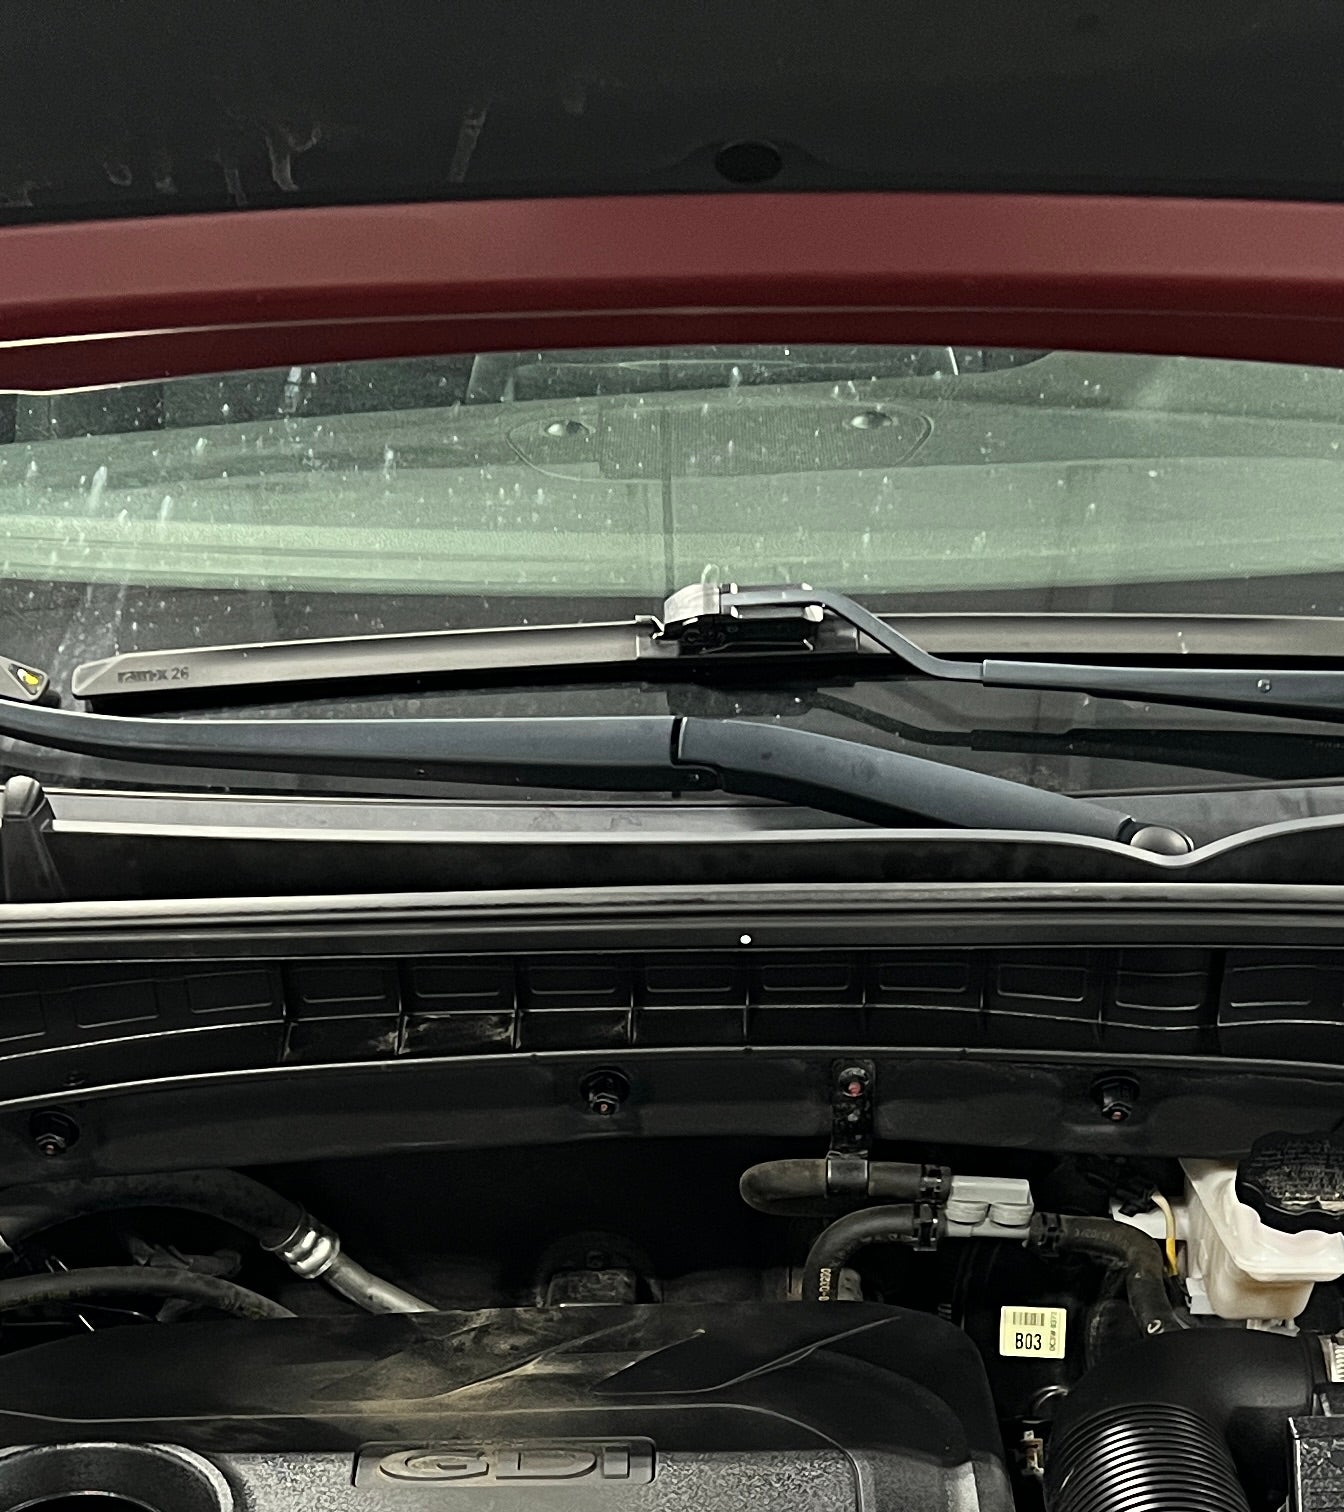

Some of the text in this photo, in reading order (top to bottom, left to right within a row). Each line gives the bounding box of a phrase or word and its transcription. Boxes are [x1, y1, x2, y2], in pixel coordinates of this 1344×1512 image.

[171, 666, 189, 680] 26
[1015, 1332, 1042, 1350] B03
[378, 1445, 631, 1482] GDI
